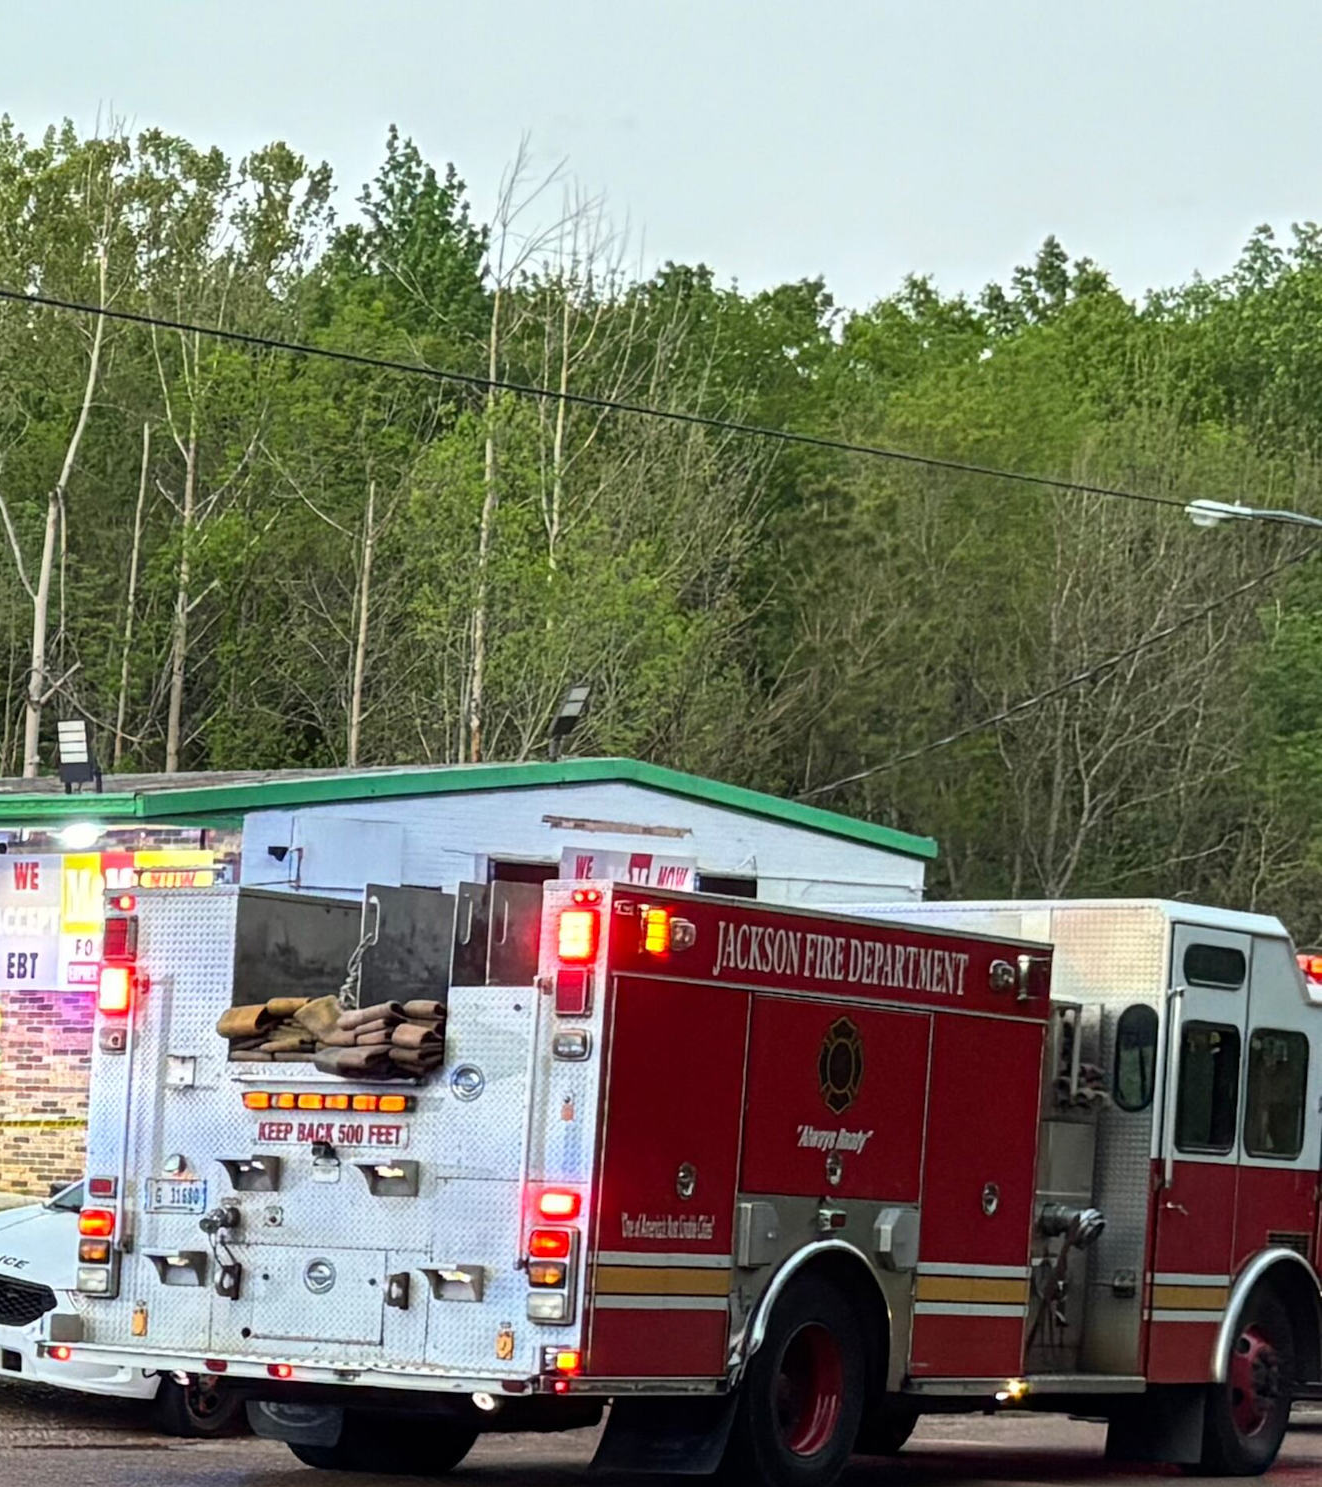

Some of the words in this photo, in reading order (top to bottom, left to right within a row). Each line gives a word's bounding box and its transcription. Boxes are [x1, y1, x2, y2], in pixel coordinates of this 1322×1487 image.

[13, 862, 39, 890] WE
[575, 855, 594, 880] WE
[6, 953, 39, 979] EBT
[712, 921, 802, 977] JACKSON
[803, 933, 846, 981] FIRE
[848, 938, 969, 995] DEPARTMENT
[258, 1121, 293, 1142] KEEP
[297, 1122, 335, 1143] BACK
[338, 1124, 363, 1144] 500
[368, 1125, 402, 1145] FEET
